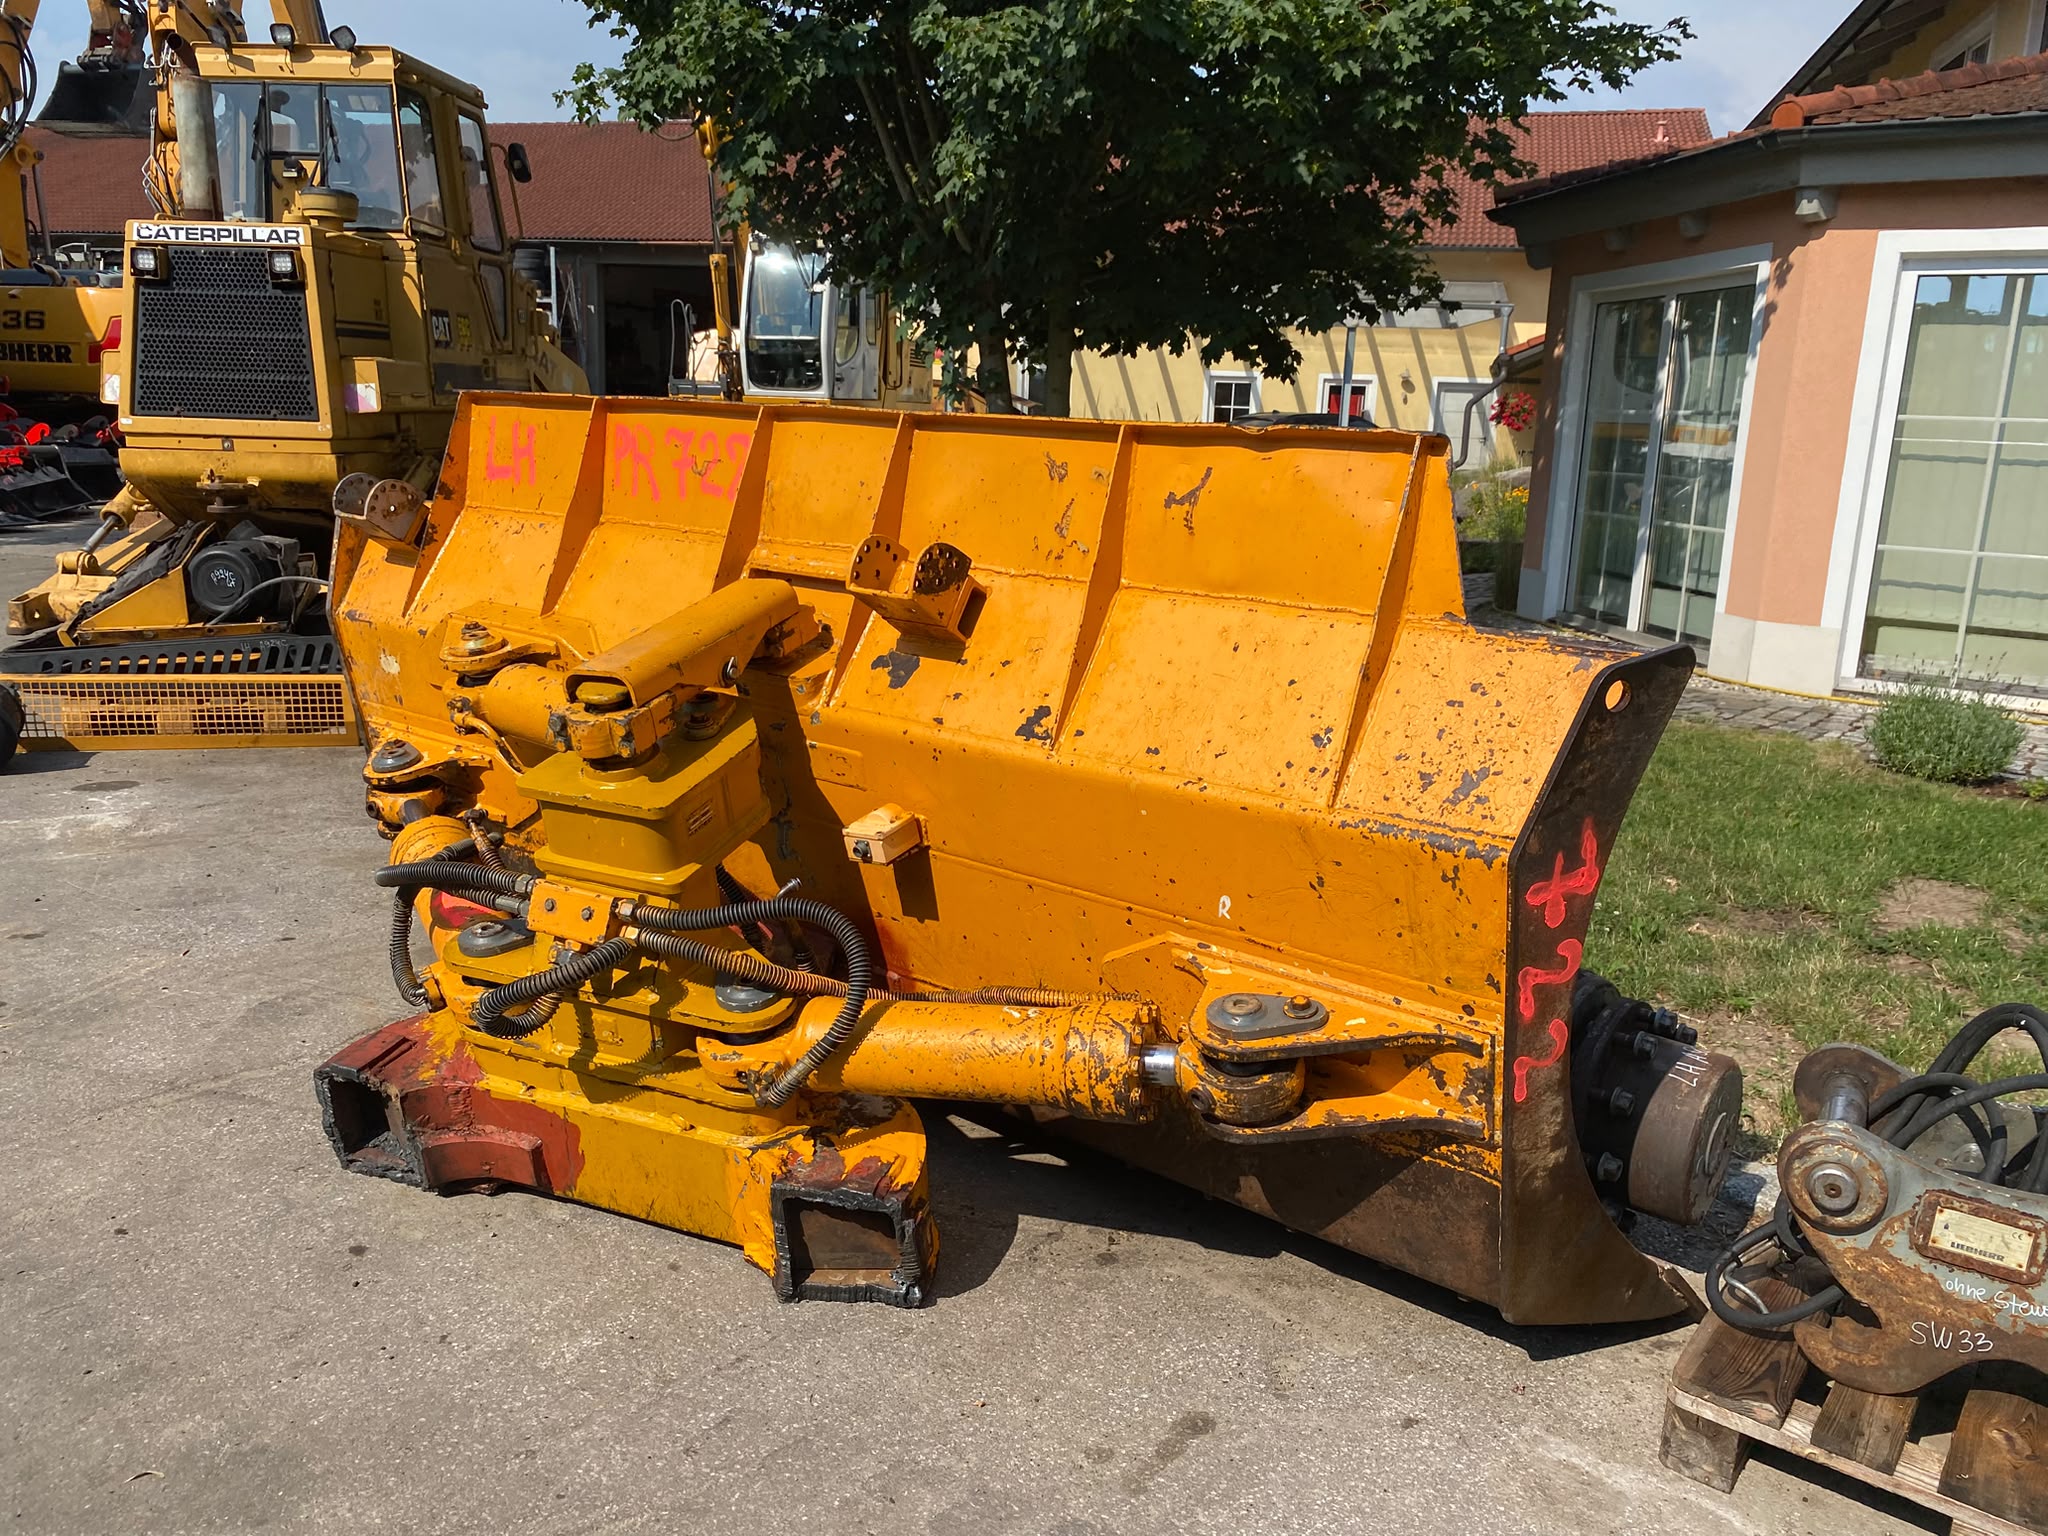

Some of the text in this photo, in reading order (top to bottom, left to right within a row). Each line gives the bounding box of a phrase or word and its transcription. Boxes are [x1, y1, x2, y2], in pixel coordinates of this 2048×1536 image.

[136, 225, 300, 244] CATERPILLAR
[2, 310, 46, 330] 36
[431, 316, 450, 341] CAT
[485, 415, 536, 487] LH
[614, 423, 662, 504] PR
[1218, 895, 1232, 920] R
[1668, 1061, 1707, 1087] LH
[1945, 1277, 1988, 1303] ohne
[1909, 1321, 1994, 1353] SW 33
